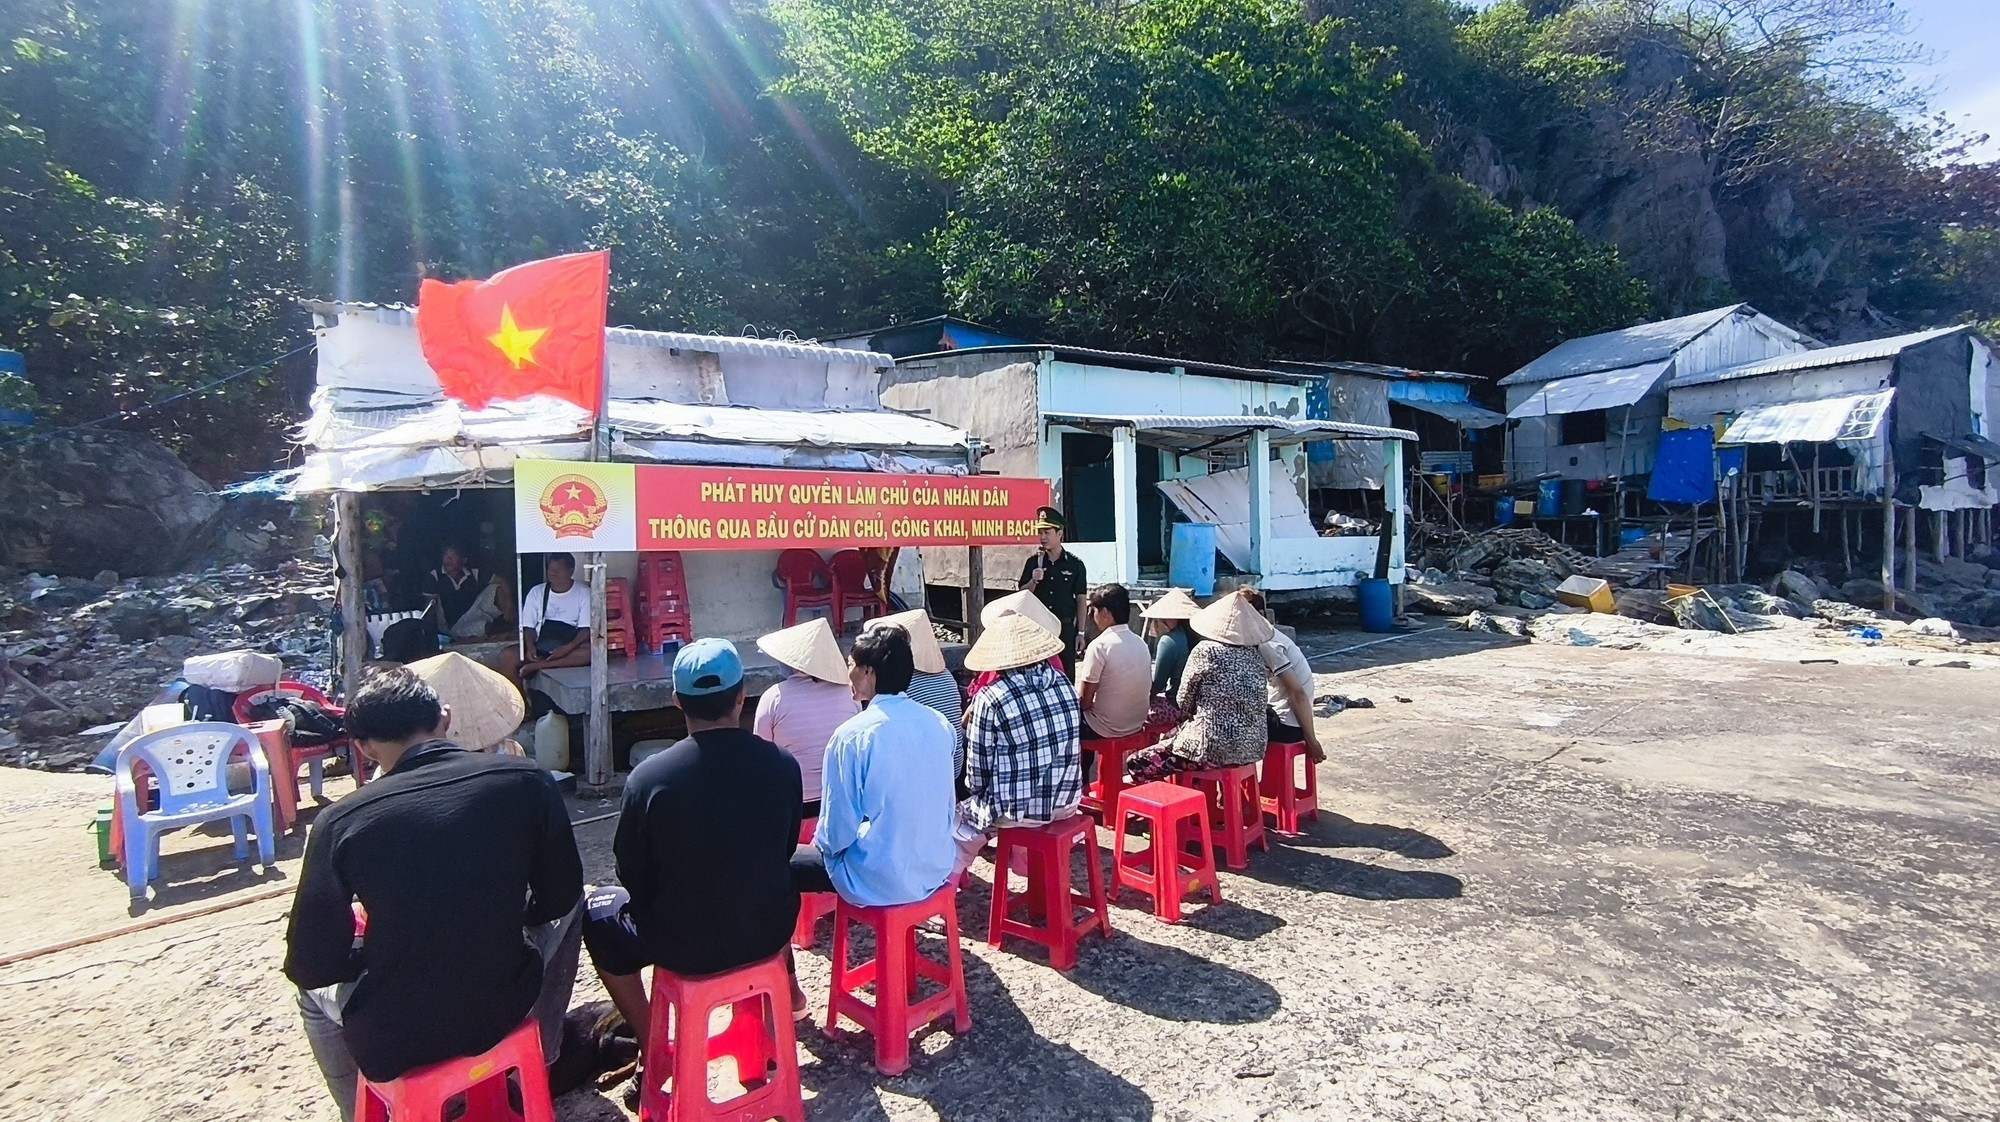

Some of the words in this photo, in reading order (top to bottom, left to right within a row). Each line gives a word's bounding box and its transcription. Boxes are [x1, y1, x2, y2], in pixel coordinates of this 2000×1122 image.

[701, 476, 747, 503] PHÁT
[751, 483, 784, 504] HUY
[788, 477, 843, 505] QUYỀN
[846, 480, 877, 505] LÀM
[879, 480, 909, 506] CHỦ
[912, 480, 940, 506] CỦA
[943, 485, 980, 506] NHÂN
[982, 486, 1009, 507] DÂN
[648, 513, 712, 539] THÔNG
[716, 518, 752, 540] QUA
[756, 510, 789, 539] BẦU
[792, 510, 817, 538] CỬ
[818, 515, 850, 539] DÂN
[853, 511, 889, 542] CHỦ,
[891, 515, 930, 538] CÔNG
[933, 519, 969, 540] KHAI,
[971, 519, 1004, 537] MINH
[1006, 519, 1039, 541] BẠCH
